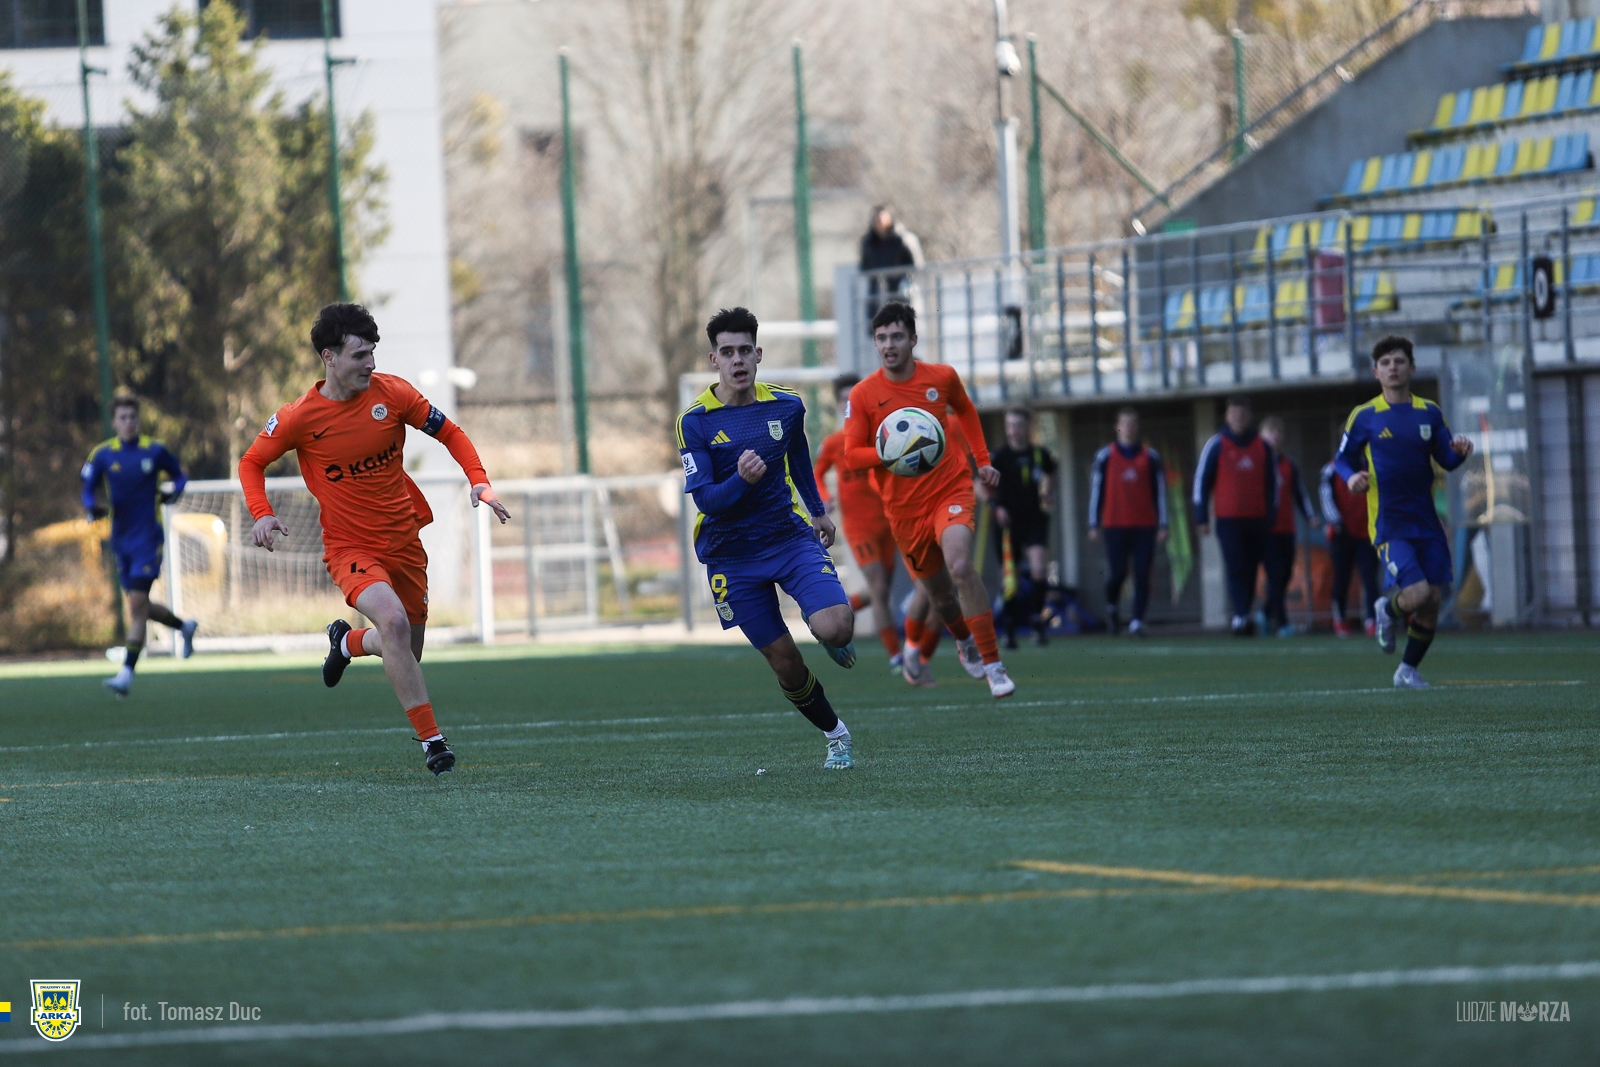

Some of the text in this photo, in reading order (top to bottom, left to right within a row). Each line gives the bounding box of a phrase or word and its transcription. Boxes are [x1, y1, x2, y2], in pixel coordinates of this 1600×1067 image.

[348, 441, 398, 476] KGHM
[906, 553, 923, 572] 2
[711, 573, 728, 603] 9
